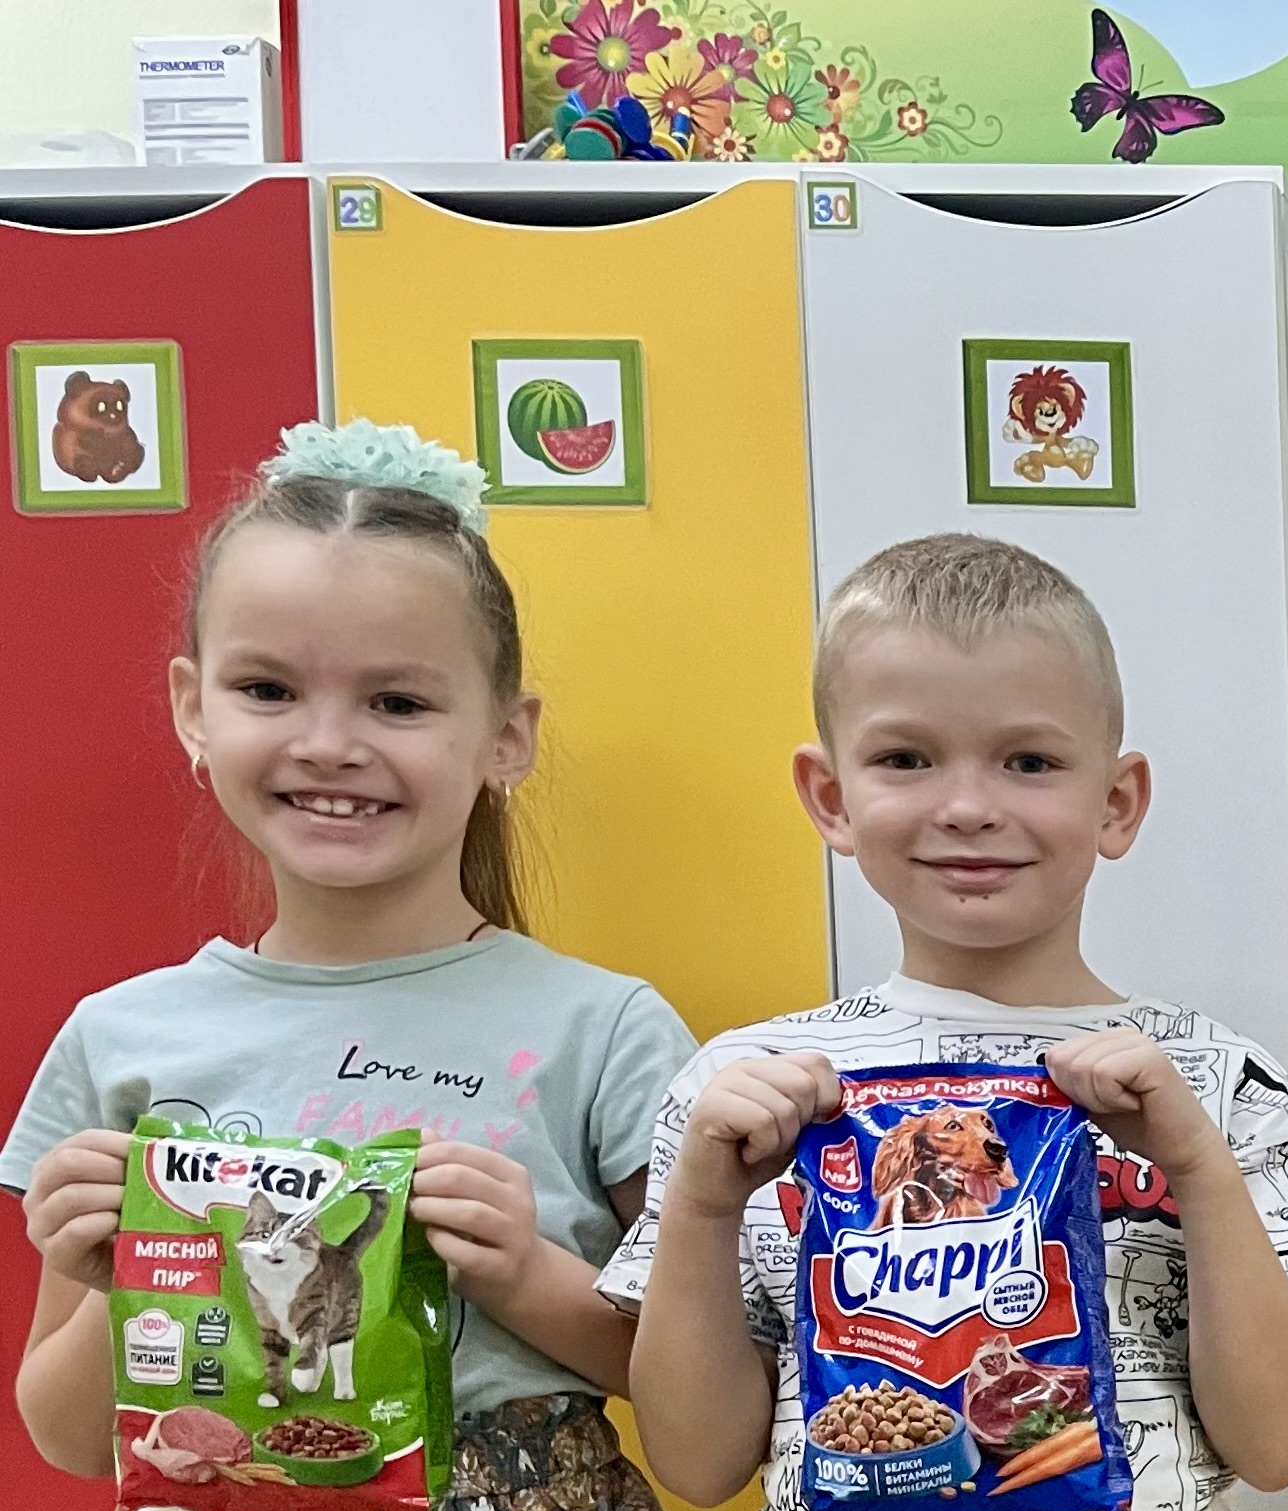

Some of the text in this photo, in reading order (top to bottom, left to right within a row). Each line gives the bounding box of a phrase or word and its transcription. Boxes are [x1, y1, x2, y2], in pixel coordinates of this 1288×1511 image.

[140, 60, 225, 72] THERMOMETER
[340, 196, 376, 223] 29
[814, 193, 851, 223] 30
[337, 1045, 484, 1098] Love my
[842, 1078, 1048, 1105] дачная покупка!
[165, 1144, 331, 1201] kitekat
[822, 1191, 861, 1214] 600г
[135, 1237, 219, 1260] МЯСНОЙ
[834, 1217, 1025, 1310] Chappi
[152, 1268, 195, 1287] ПИР
[993, 1280, 1035, 1295] СЫТНЫЙ
[130, 1352, 177, 1366] ПИТАНИЕ
[814, 1457, 869, 1486] 100%
[884, 1458, 923, 1473] БЕЛКИ
[886, 1461, 952, 1486] ВИТАМИНЫ
[887, 1474, 952, 1495] МИНЕРАЛЫ
